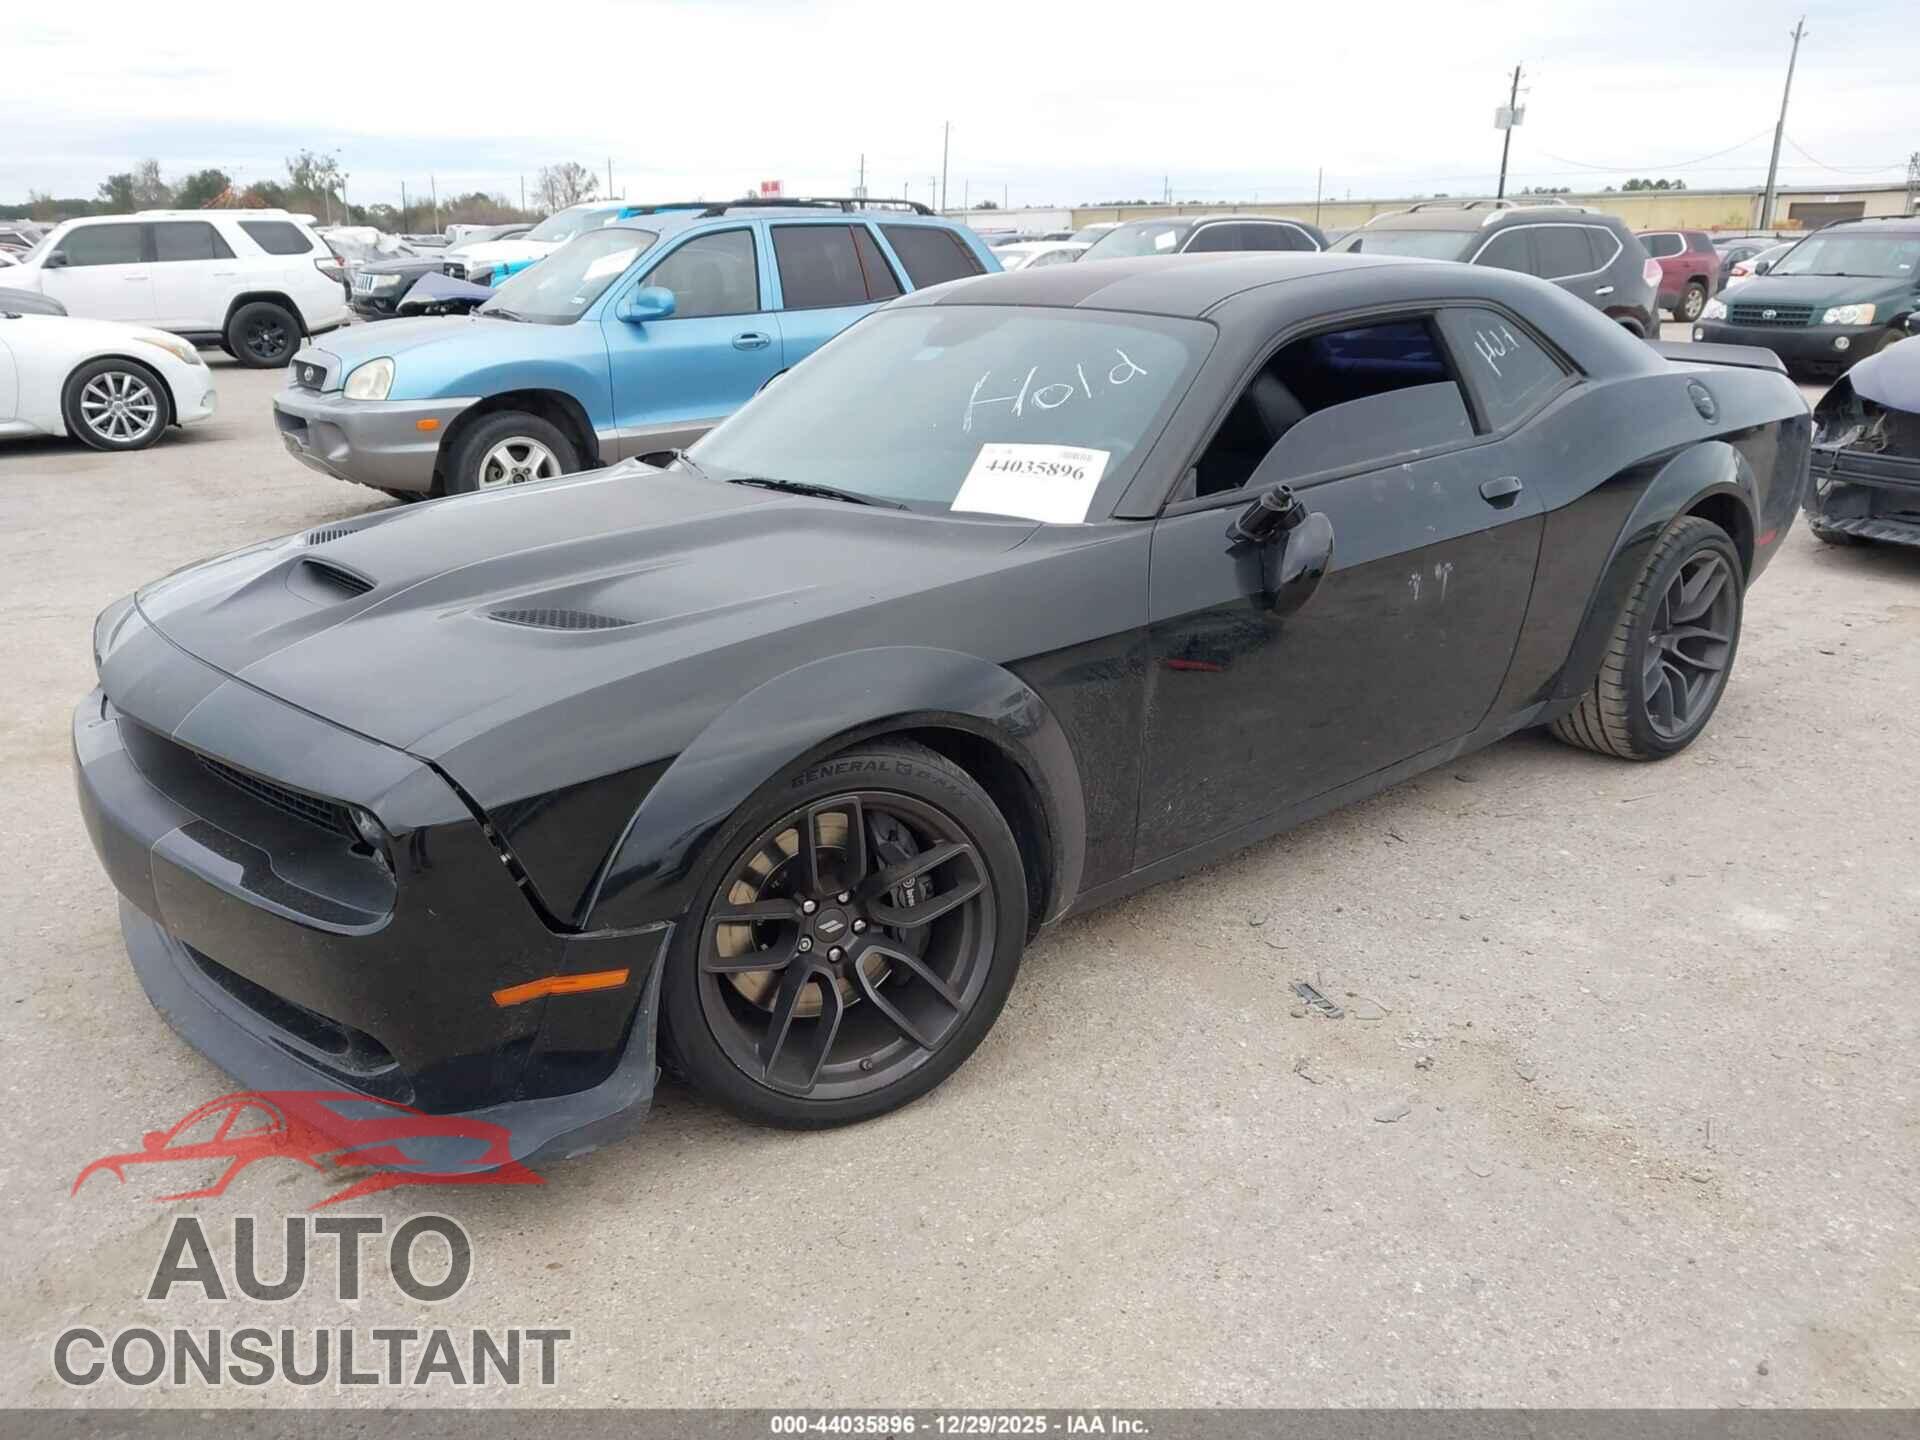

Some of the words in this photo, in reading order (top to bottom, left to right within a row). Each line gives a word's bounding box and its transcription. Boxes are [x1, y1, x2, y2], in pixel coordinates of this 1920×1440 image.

[963, 348, 1148, 432] Hold
[986, 460, 1085, 480] 44035896
[791, 760, 891, 788] GENERAL
